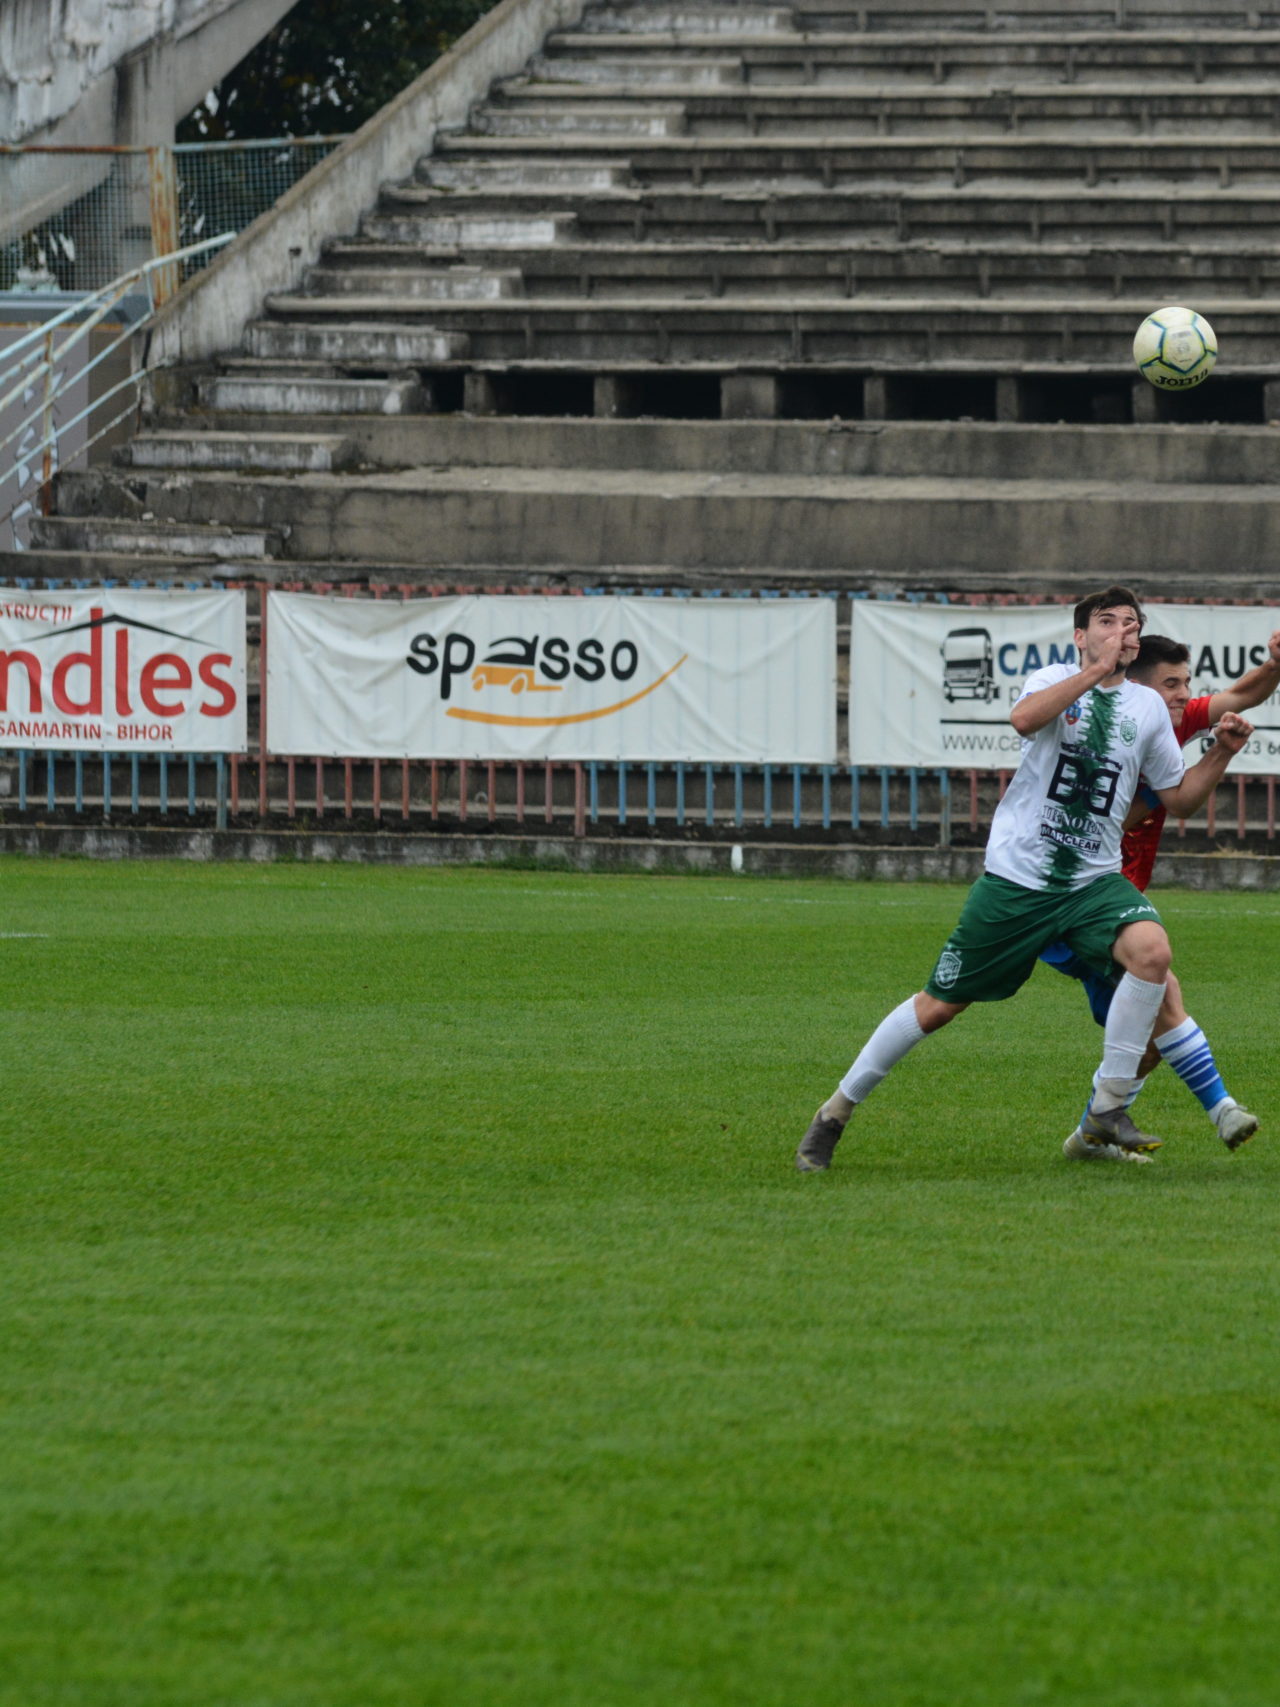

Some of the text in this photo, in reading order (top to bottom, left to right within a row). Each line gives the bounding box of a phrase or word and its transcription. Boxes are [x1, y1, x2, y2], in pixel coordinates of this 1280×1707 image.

[0, 608, 237, 717] ndles
[406, 633, 638, 700] spasso
[117, 724, 173, 740] BIHOR
